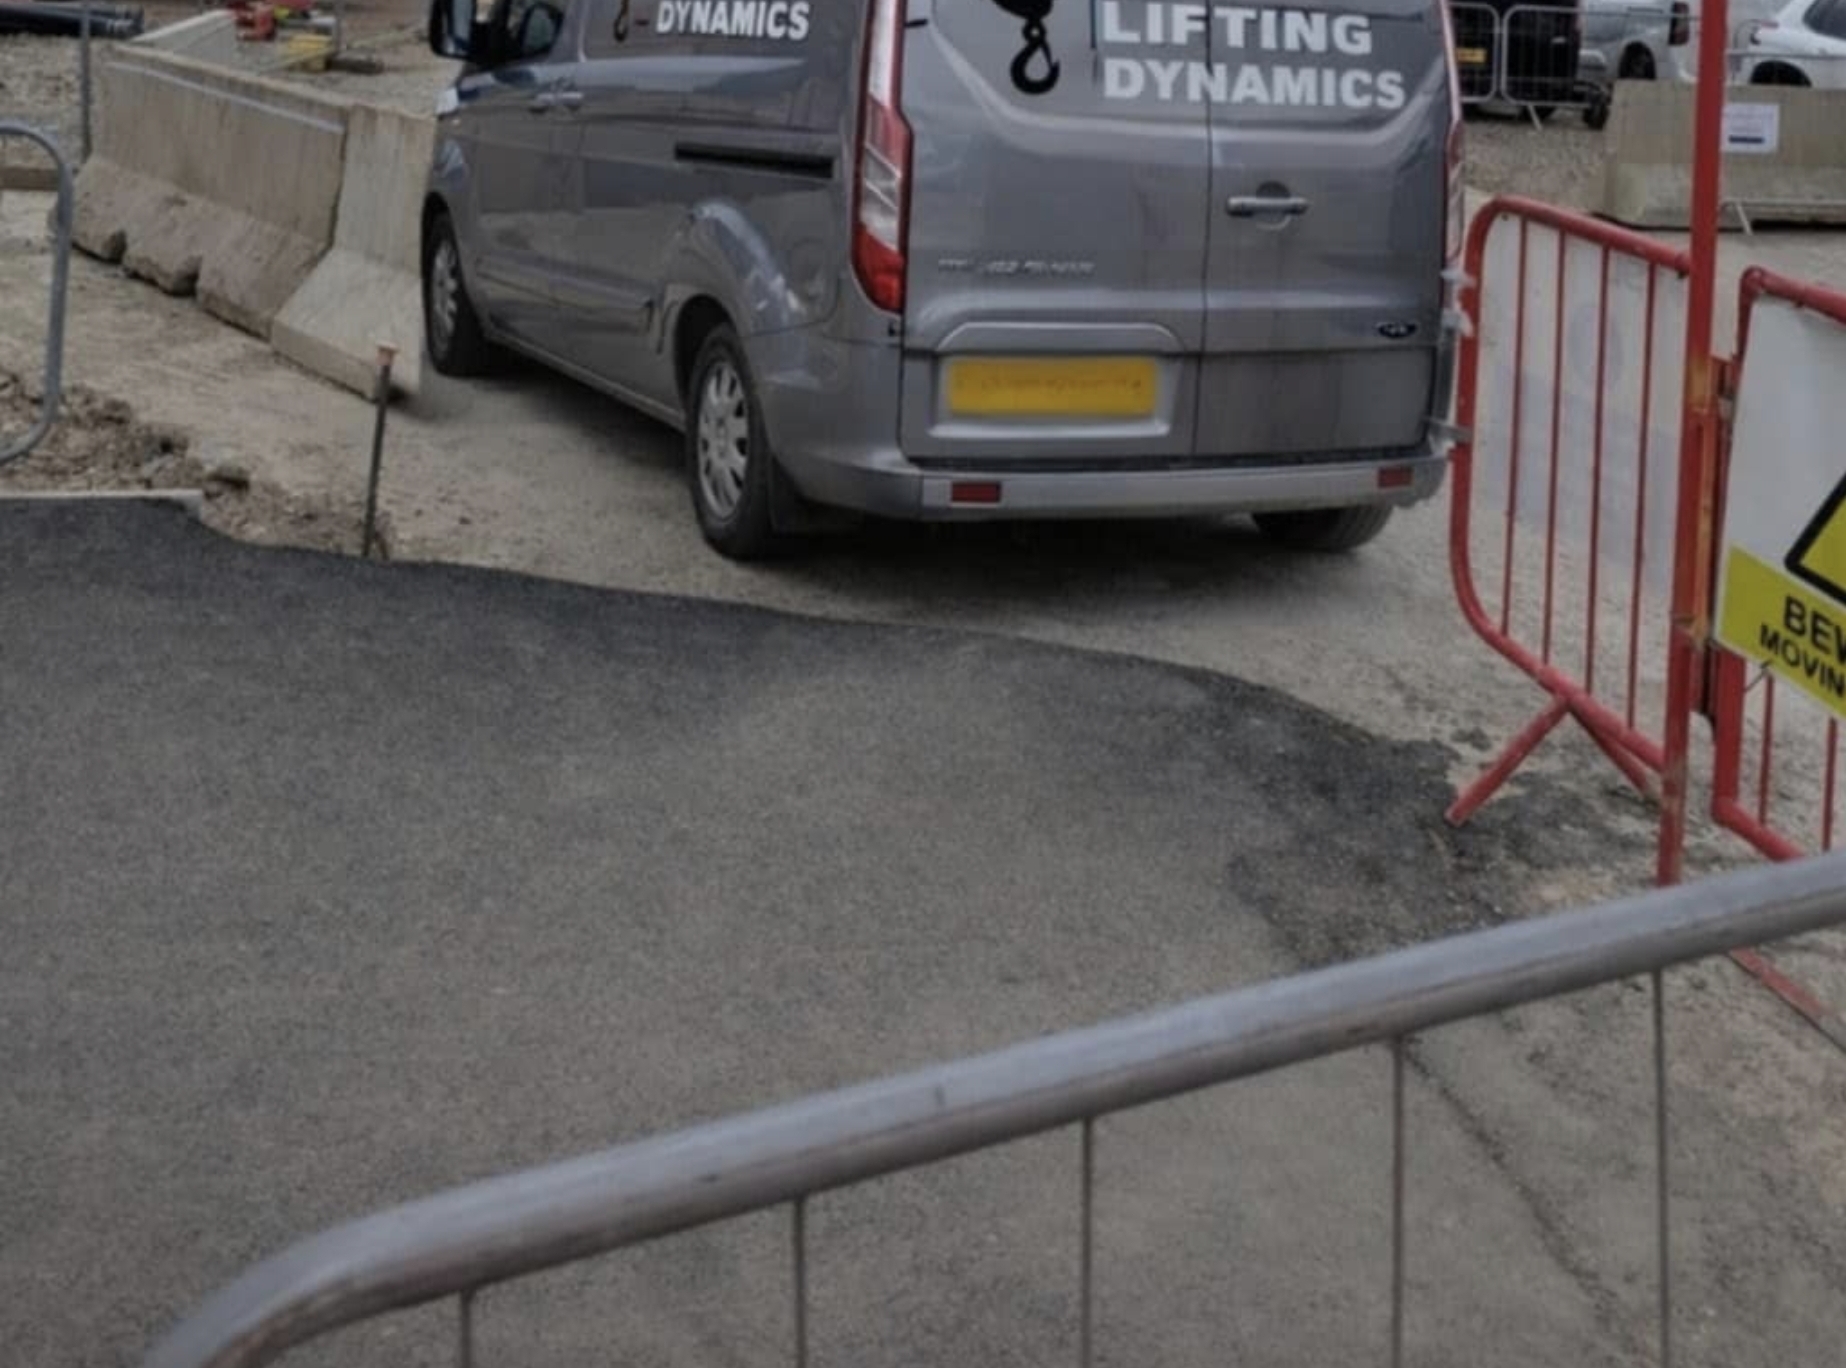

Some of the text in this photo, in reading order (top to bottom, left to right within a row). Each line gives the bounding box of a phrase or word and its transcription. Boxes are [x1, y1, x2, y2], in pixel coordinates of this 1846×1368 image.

[656, 0, 810, 40] DYNAMICS
[1103, 0, 1372, 55] LIFTING
[1104, 58, 1405, 110] DYNAMICS
